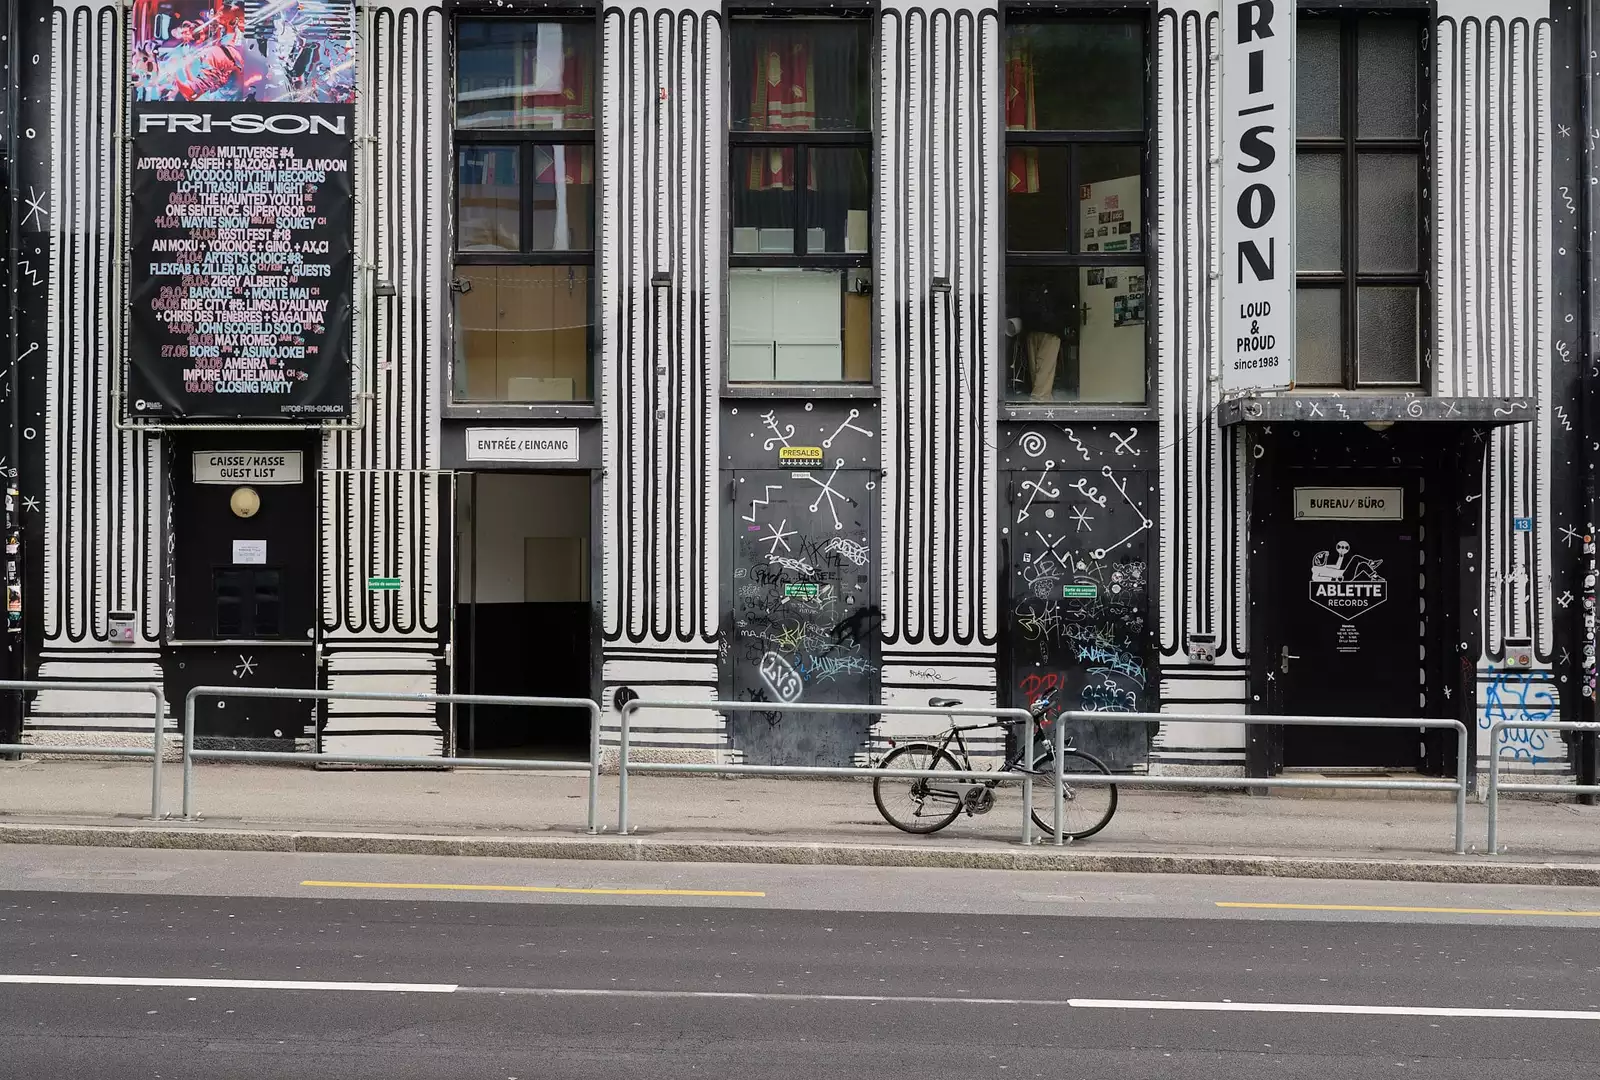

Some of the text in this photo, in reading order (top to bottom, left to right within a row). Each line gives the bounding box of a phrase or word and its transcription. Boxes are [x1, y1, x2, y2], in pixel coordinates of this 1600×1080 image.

[138, 113, 346, 135] FRI-SON
[188, 145, 294, 159] 07.04 MULTIVERSE #4
[136, 157, 181, 170] ADT2000
[190, 157, 225, 170] ASIFEH
[233, 158, 276, 170] BAZOGA
[285, 158, 314, 171] LEILA
[315, 159, 347, 172] MOON
[186, 169, 233, 181] VOODOO
[233, 170, 278, 182] RHYTHM
[278, 170, 326, 183] RECORDS
[177, 181, 305, 194] LO-FI TRASH LABEL NIGHT
[199, 193, 219, 205] THE
[220, 193, 267, 206] HAUNTED
[268, 193, 303, 206] YOUTH
[165, 204, 187, 217] ONE
[242, 204, 306, 218] SUPERVISOR
[306, 205, 316, 213] CH
[180, 216, 217, 229] WAYNE
[218, 216, 250, 229] SNOW
[275, 217, 317, 230] SOUKEY
[317, 217, 327, 225] CH
[246, 228, 272, 241] FEST
[272, 229, 292, 241] #18
[151, 239, 167, 252] AN
[168, 239, 198, 252] MOKU
[207, 240, 256, 252] YOKONOE
[204, 251, 249, 264] ARTIST'S
[249, 252, 287, 264] CHOICE
[149, 263, 191, 275] FLEXFAB
[192, 264, 200, 275] &
[201, 263, 235, 275] ZILLER
[236, 264, 257, 276] BAS
[291, 264, 331, 277] GUESTS
[210, 275, 241, 287] ZIGGY
[242, 275, 288, 288] ALBERTS
[251, 287, 289, 299] MONTE
[289, 287, 310, 299] MAI
[180, 298, 203, 311] RIDE
[204, 298, 228, 311] CITY
[246, 299, 279, 312] LIMSA
[1240, 301, 1271, 319] LOUD
[163, 310, 193, 322] CHRIS
[194, 310, 214, 322] DES
[271, 311, 325, 324] SAGALINA
[195, 322, 223, 334] JOHN
[223, 322, 273, 335] SCOFIELD
[273, 322, 302, 335] SOLO
[1250, 320, 1260, 335] &
[214, 334, 239, 346] MAX
[240, 334, 278, 346] ROMEO
[1236, 335, 1276, 353] PROUD
[189, 345, 220, 358] BORIS
[241, 346, 305, 359] ASUNOJOKEI
[224, 357, 269, 370] AMENRA
[1233, 356, 1279, 370] since 1983
[183, 368, 221, 381] IMPURE
[221, 369, 286, 381] WILHELMINA
[215, 381, 259, 393] CLOSING
[260, 381, 294, 394] PARTY
[782, 449, 820, 457] PRESALES
[220, 468, 275, 478] GUEST LIST
[1517, 520, 1529, 529] 13
[1315, 584, 1382, 597] ABLETTE
[1327, 599, 1369, 607] RECORDS
